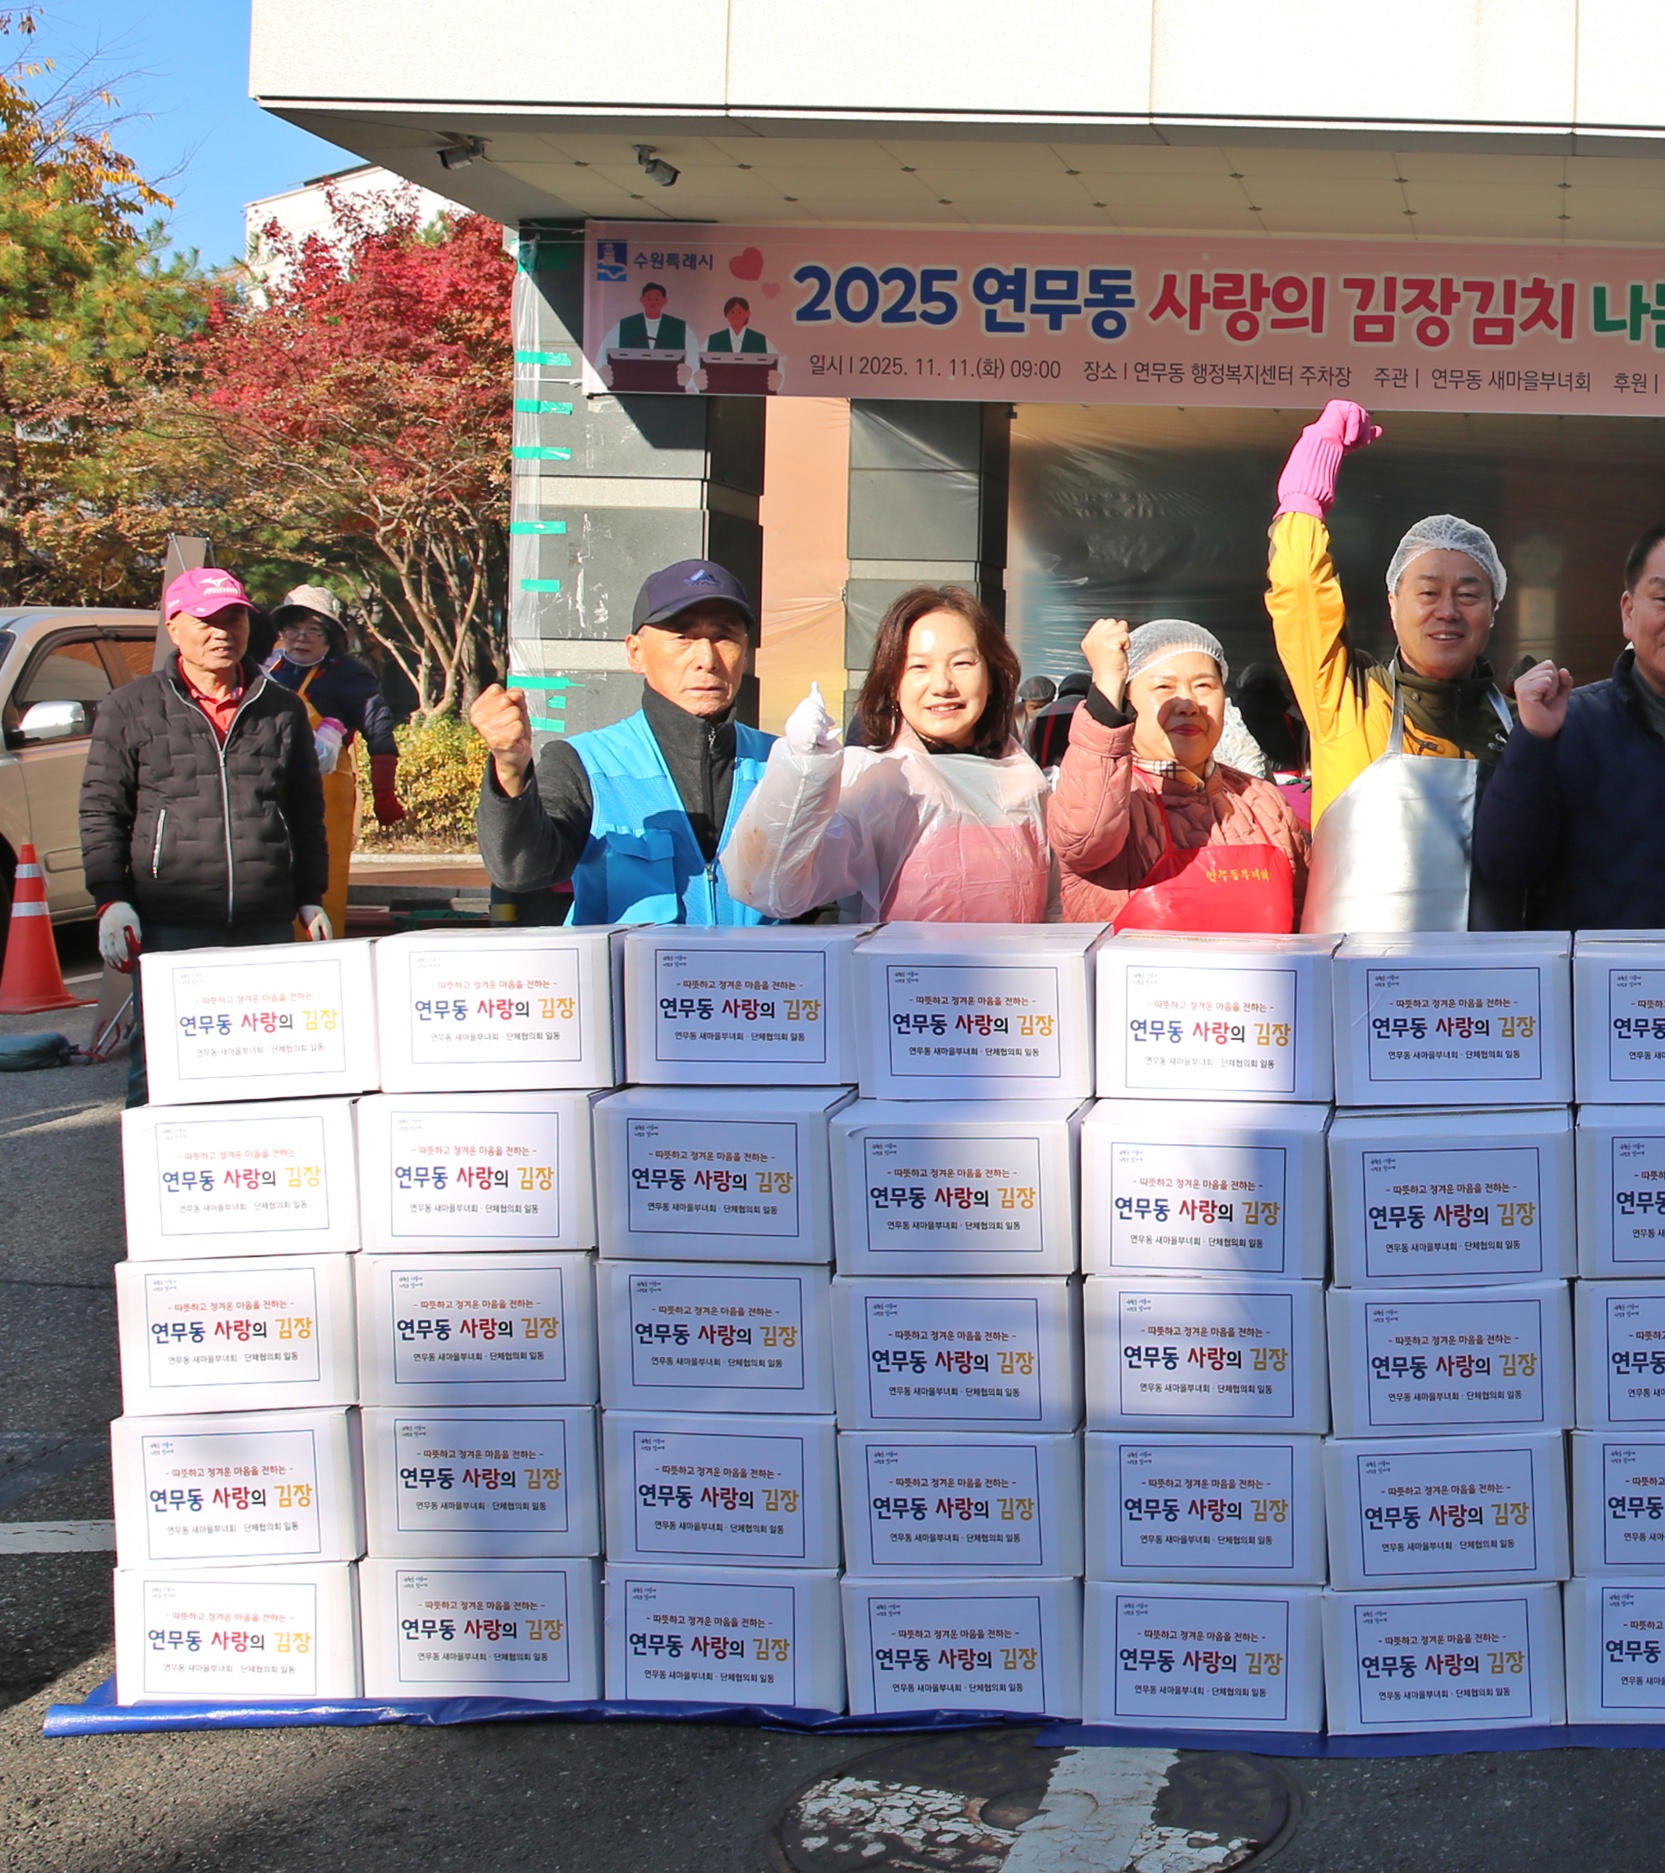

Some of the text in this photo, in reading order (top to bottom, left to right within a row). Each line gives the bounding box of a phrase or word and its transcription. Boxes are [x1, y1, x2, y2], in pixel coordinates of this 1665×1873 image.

[633, 251, 715, 272] 수원특례시
[795, 265, 958, 325] 2025
[973, 267, 1135, 339] 연무동
[1147, 272, 1326, 343] 사랑의
[1342, 275, 1576, 348] 김장김치
[809, 354, 843, 376] 일시
[859, 356, 907, 376] 2025.
[916, 358, 941, 377] 11.
[1010, 359, 1061, 379] 09:00
[1083, 361, 1118, 382] 장소
[1134, 362, 1185, 384] 연무동
[1191, 363, 1293, 386] 행정복지센터
[1299, 366, 1352, 388] 주차장
[1374, 368, 1409, 389] 주관
[1431, 368, 1483, 391] 연무동
[1488, 370, 1591, 393] 새마을부녀회
[1613, 373, 1647, 394] 후원
[916, 996, 1030, 1006] 따뜻하고 정겨운 마음을 전하는
[179, 1008, 340, 1038] 연무동 사랑의 김장
[892, 1013, 1055, 1036] 연무동 사랑의 김장
[909, 1047, 1039, 1056] 연무동 새마을부녀회 단체협의회 일동
[632, 1167, 794, 1194] 연무동 사랑의 김장
[1368, 1202, 1537, 1231] 연무동 사랑의 김장
[397, 1317, 560, 1341] 연무동 사랑의 김장
[1148, 1326, 1264, 1338] 따뜻하고 정겨운 마음을 전하는
[1124, 1345, 1289, 1372] 연무동 사랑의 김장
[1140, 1383, 1272, 1394] 연무동 새마을부녀회 단체협의회 일동
[149, 1483, 314, 1514] 연무동 사랑의 김장
[872, 1497, 1036, 1521] 연무동 사랑의 김장
[1608, 1495, 1664, 1520] 연무동
[653, 1614, 766, 1628] 따뜻하고 정겨운 마음을 전하는
[629, 1632, 791, 1662] 연무동 사랑의 김장
[644, 1670, 774, 1683] 연무동 새마을부녀회 단체협의회 일동
[1361, 1651, 1526, 1680] 연무동 사랑의 김장
